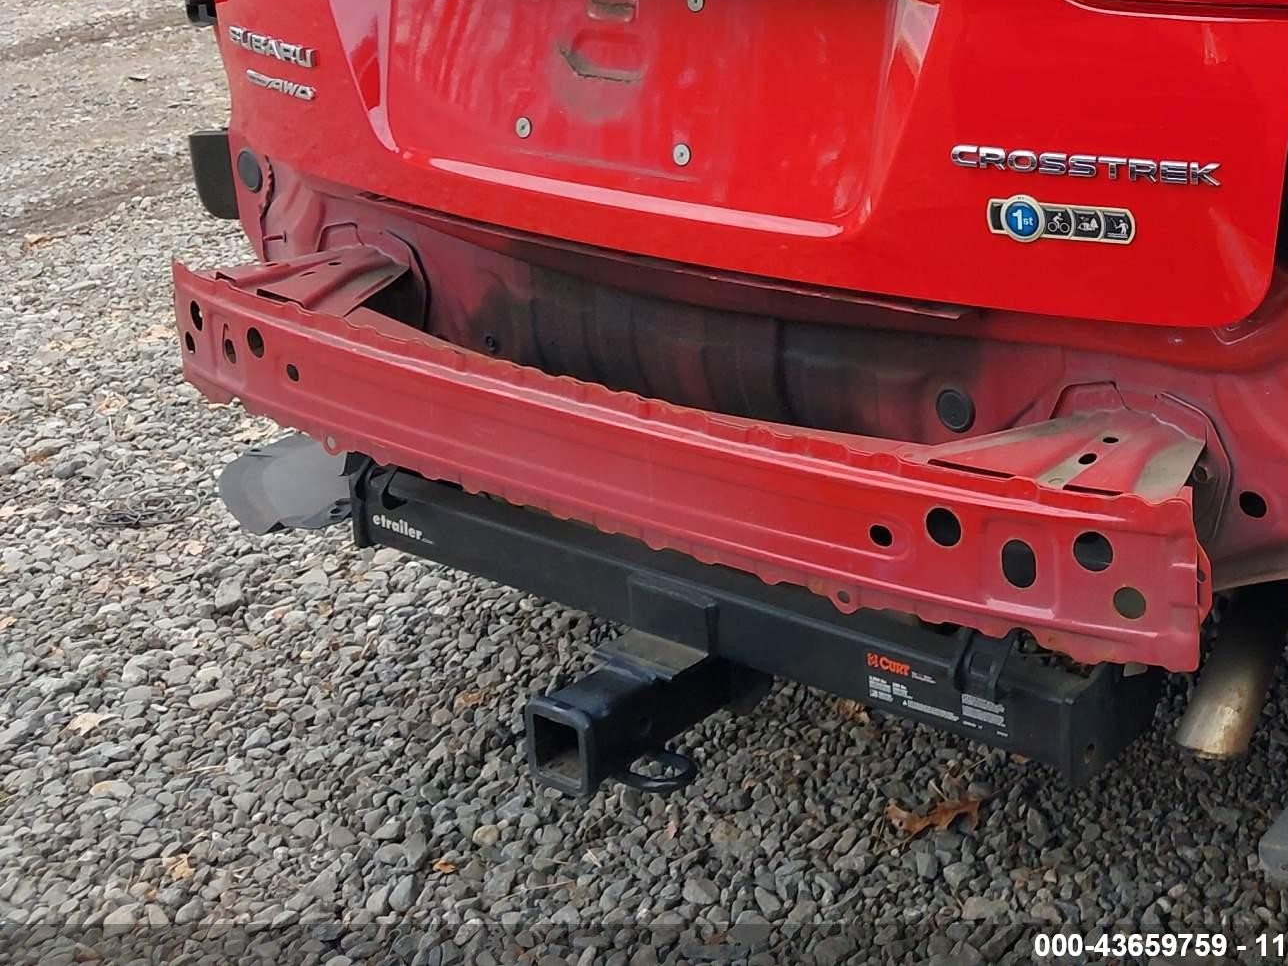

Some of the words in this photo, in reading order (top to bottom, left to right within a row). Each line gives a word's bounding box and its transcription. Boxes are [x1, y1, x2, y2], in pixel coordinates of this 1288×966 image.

[228, 26, 316, 68] SUBARU
[950, 144, 1222, 186] CROSSTREK
[1012, 209, 1034, 230] 1st
